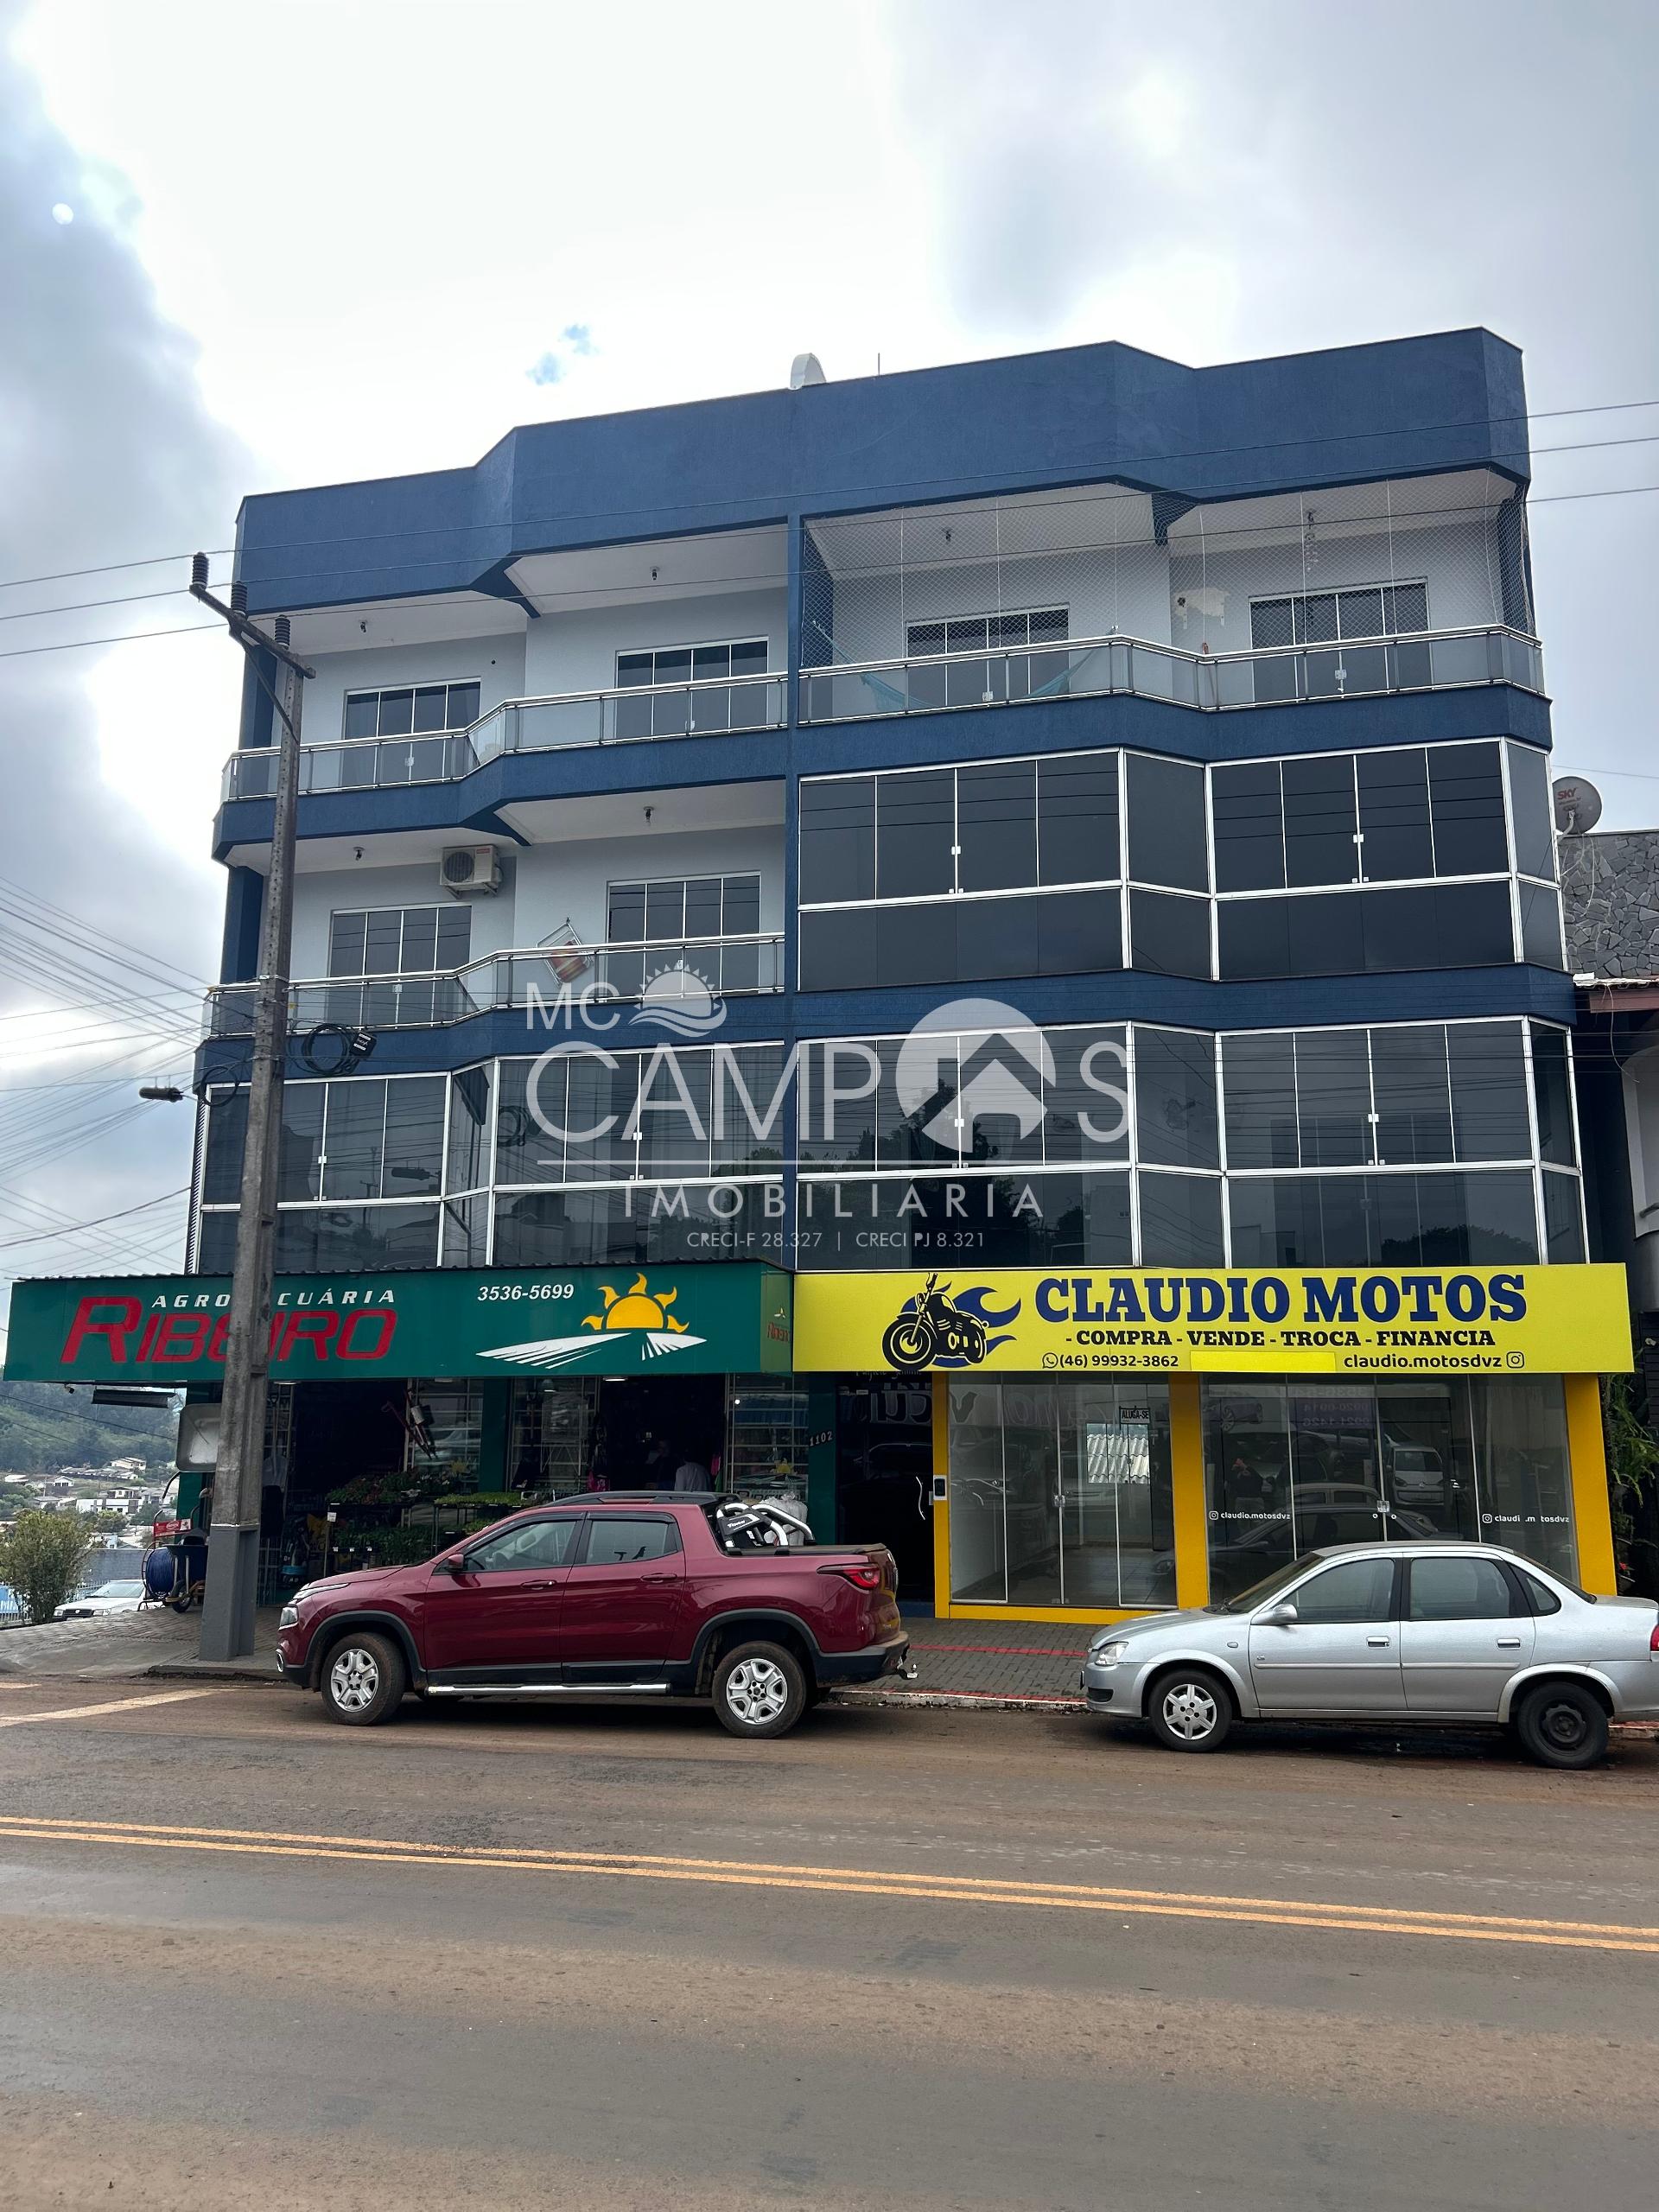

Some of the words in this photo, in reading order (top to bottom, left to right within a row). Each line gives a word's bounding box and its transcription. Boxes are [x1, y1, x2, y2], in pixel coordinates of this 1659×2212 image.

[1557, 787, 1576, 800] SKY
[150, 1290, 396, 1309] AGROCUÁRIA
[477, 1284, 575, 1301] 3536-5699
[1034, 1276, 1291, 1324] CLAUDIO
[1301, 1274, 1527, 1323] MOTOS
[1076, 1330, 1173, 1346] COMPRA
[1186, 1331, 1265, 1346] VENDE
[1281, 1331, 1361, 1346] TROCA
[1376, 1330, 1496, 1346] FINANCIA
[1059, 1354, 1088, 1369] (46)
[1091, 1355, 1179, 1367] 99932-3862
[1344, 1354, 1502, 1368] claudio.motosdvz
[1122, 1410, 1149, 1419] ALUGA-SE
[809, 1430, 833, 1446] 1102
[1220, 1511, 1291, 1520] claudio.motosdvz
